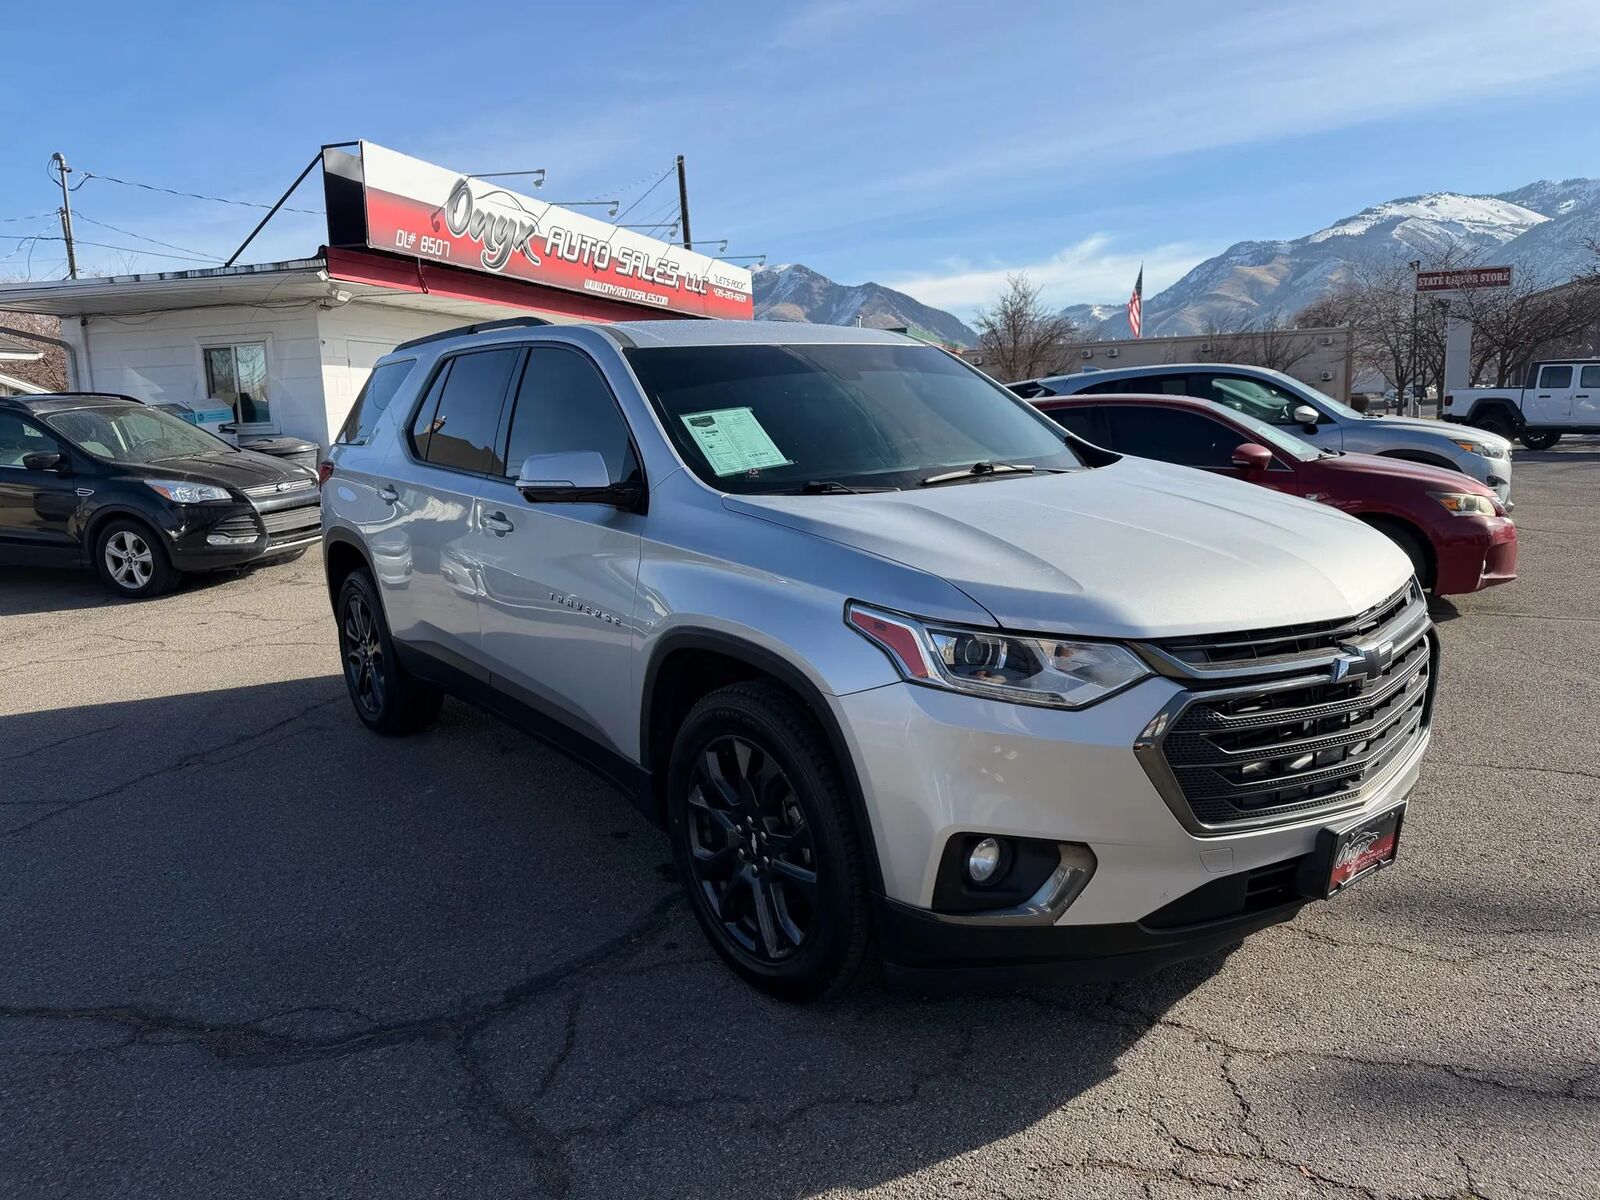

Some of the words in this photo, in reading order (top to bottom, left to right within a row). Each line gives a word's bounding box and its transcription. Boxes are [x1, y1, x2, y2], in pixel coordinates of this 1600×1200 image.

[395, 229, 416, 249] DL#
[420, 236, 450, 258] 8507
[445, 177, 541, 272] Onyx
[545, 225, 611, 270] AUTO
[615, 246, 679, 290] SALES,
[684, 272, 709, 295] LLC
[1418, 276, 1444, 286] STATE
[1480, 271, 1509, 282] STORE
[549, 592, 622, 627] TRAVERSE
